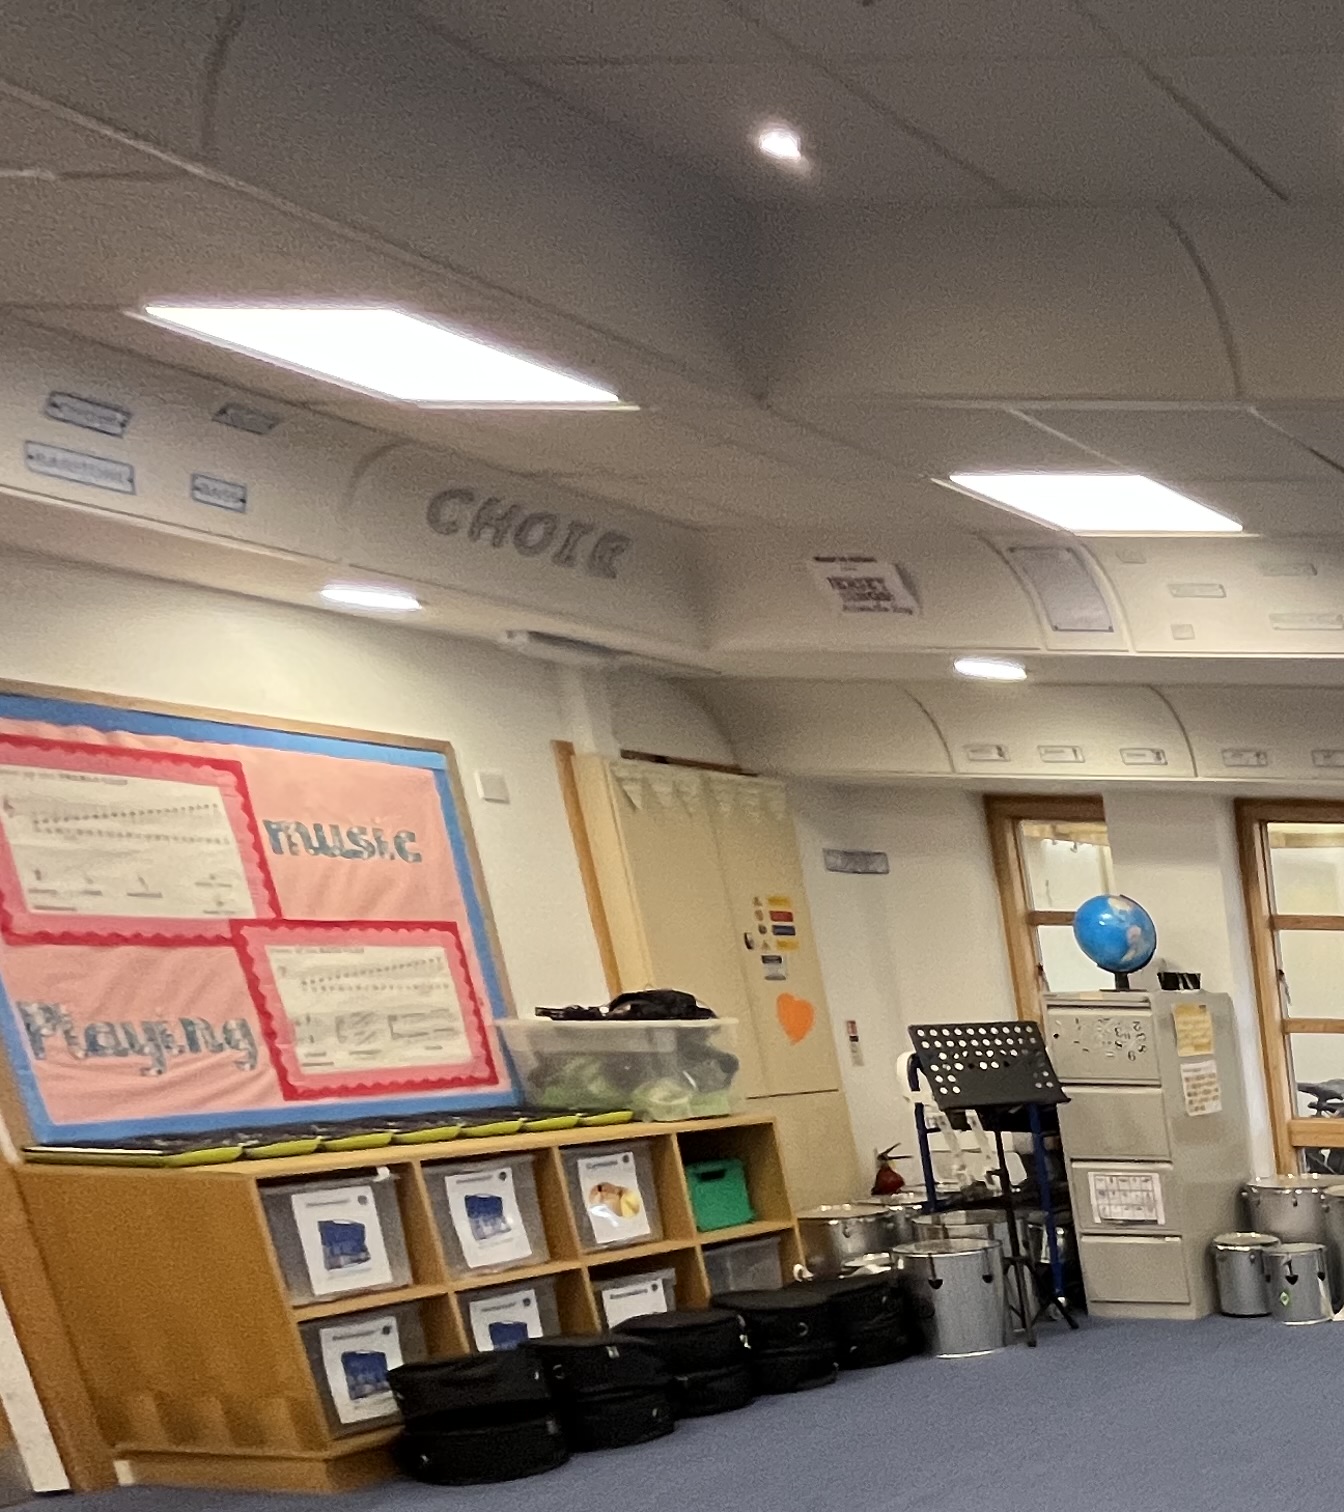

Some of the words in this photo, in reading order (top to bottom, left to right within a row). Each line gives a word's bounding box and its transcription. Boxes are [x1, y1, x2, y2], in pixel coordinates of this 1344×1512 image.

[426, 486, 633, 580] CHOIR
[262, 814, 423, 865] music
[16, 1001, 259, 1077] Playing
